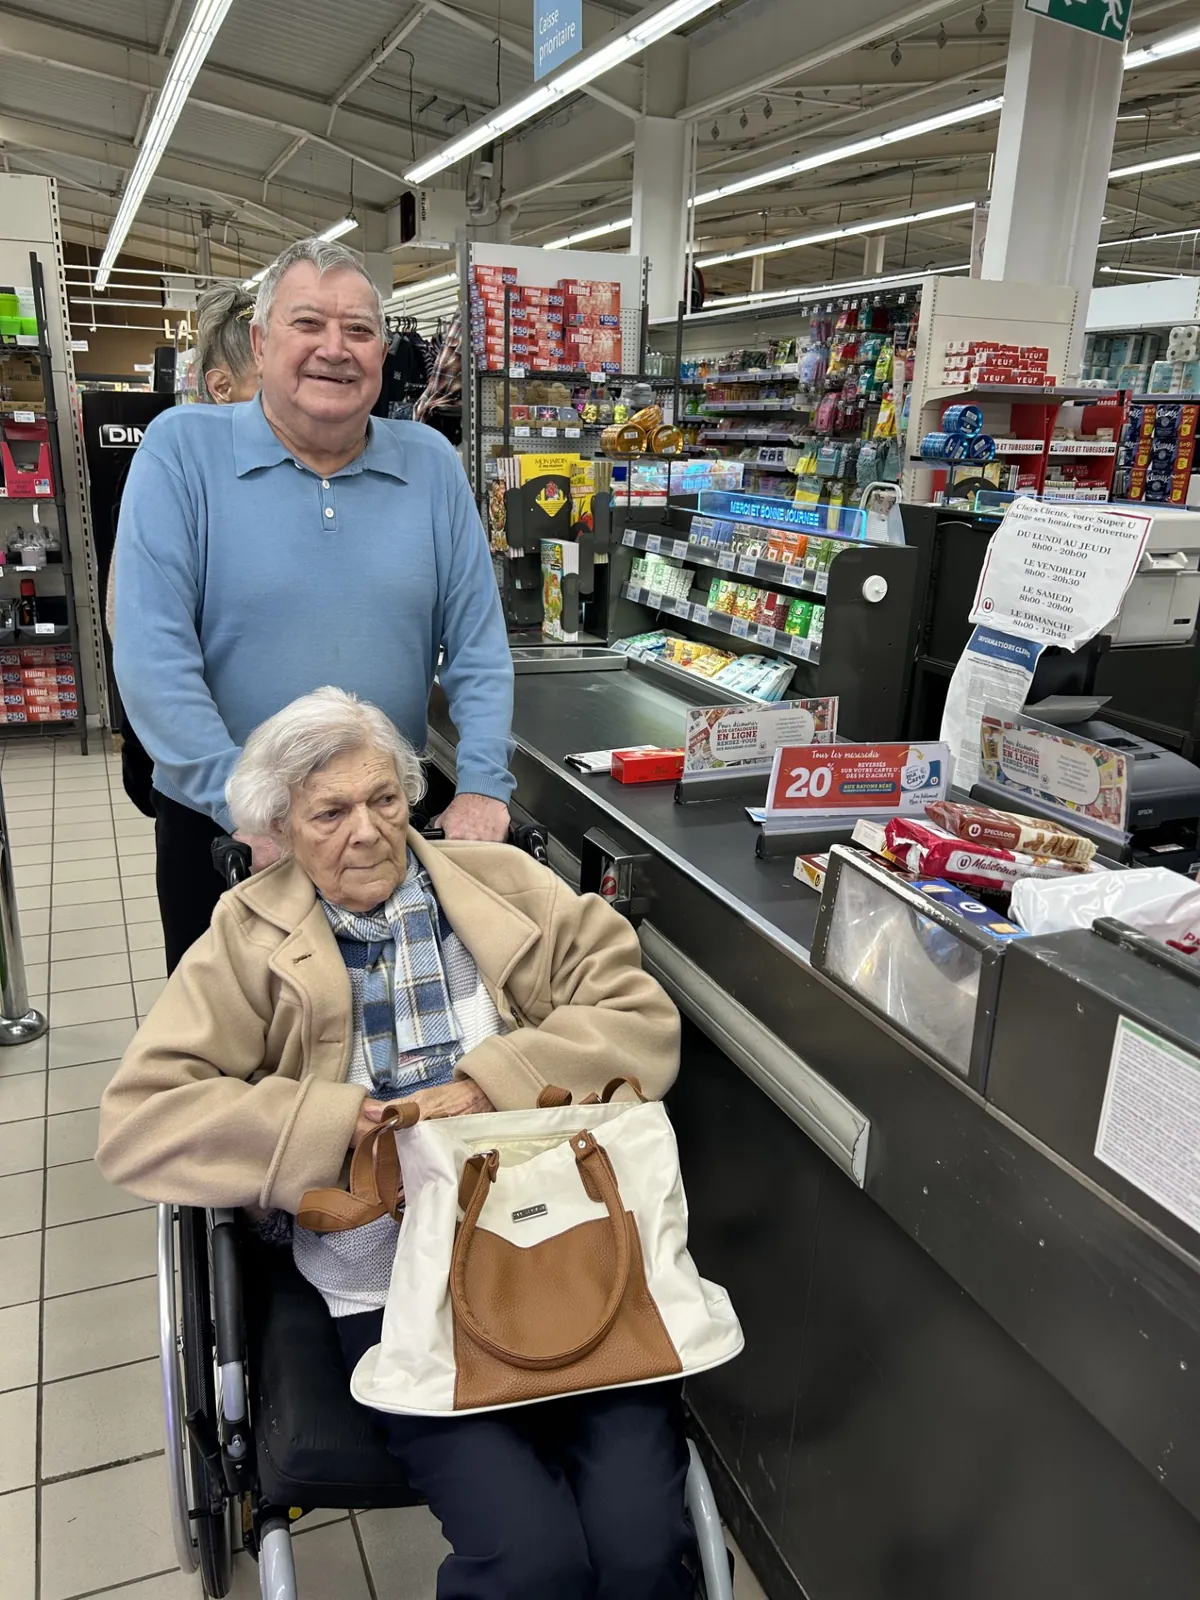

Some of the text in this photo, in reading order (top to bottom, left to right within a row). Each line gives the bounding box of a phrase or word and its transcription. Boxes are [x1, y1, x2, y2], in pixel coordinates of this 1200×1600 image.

[539, 9, 559, 35] Caisse
[539, 22, 576, 67] prioritaire
[600, 315, 618, 323] 1000
[730, 501, 751, 515] MERCI
[751, 504, 760, 517] ET
[761, 506, 785, 521] BONNE
[1016, 503, 1137, 530] Chers Clients, votre Super U
[1033, 515, 1046, 523] ses
[1047, 517, 1083, 530] horaires
[1084, 523, 1140, 541] d'ouverture
[1016, 529, 1112, 556] DU LUNDI AU JEUDI
[1031, 542, 1053, 553] 8h00
[1060, 547, 1089, 560] 20h00
[1023, 558, 1088, 579] LE VENDREDI
[1024, 567, 1046, 579] 8h00
[1052, 574, 1080, 587] 20h30
[1018, 593, 1042, 605] 8h00
[1047, 601, 1074, 614] 20h00
[1022, 585, 1072, 604] LE SAMEDI
[1010, 608, 1021, 618] LE
[1023, 611, 1074, 633] DIMANCHE
[1012, 618, 1034, 630] 8h00
[1041, 626, 1067, 640] 12h45
[717, 733, 729, 741] EN
[731, 730, 758, 740] LIGNE
[728, 725, 758, 733] CATALOGUES
[716, 738, 757, 747] RENDEZ-VOUS
[812, 749, 880, 759] Tous les mercredis
[1003, 749, 1040, 768] EN LIGNE
[785, 762, 835, 798] 20%
[906, 772, 917, 780] ma
[907, 774, 925, 785] Carte
[983, 828, 1016, 839] SPECULOOS
